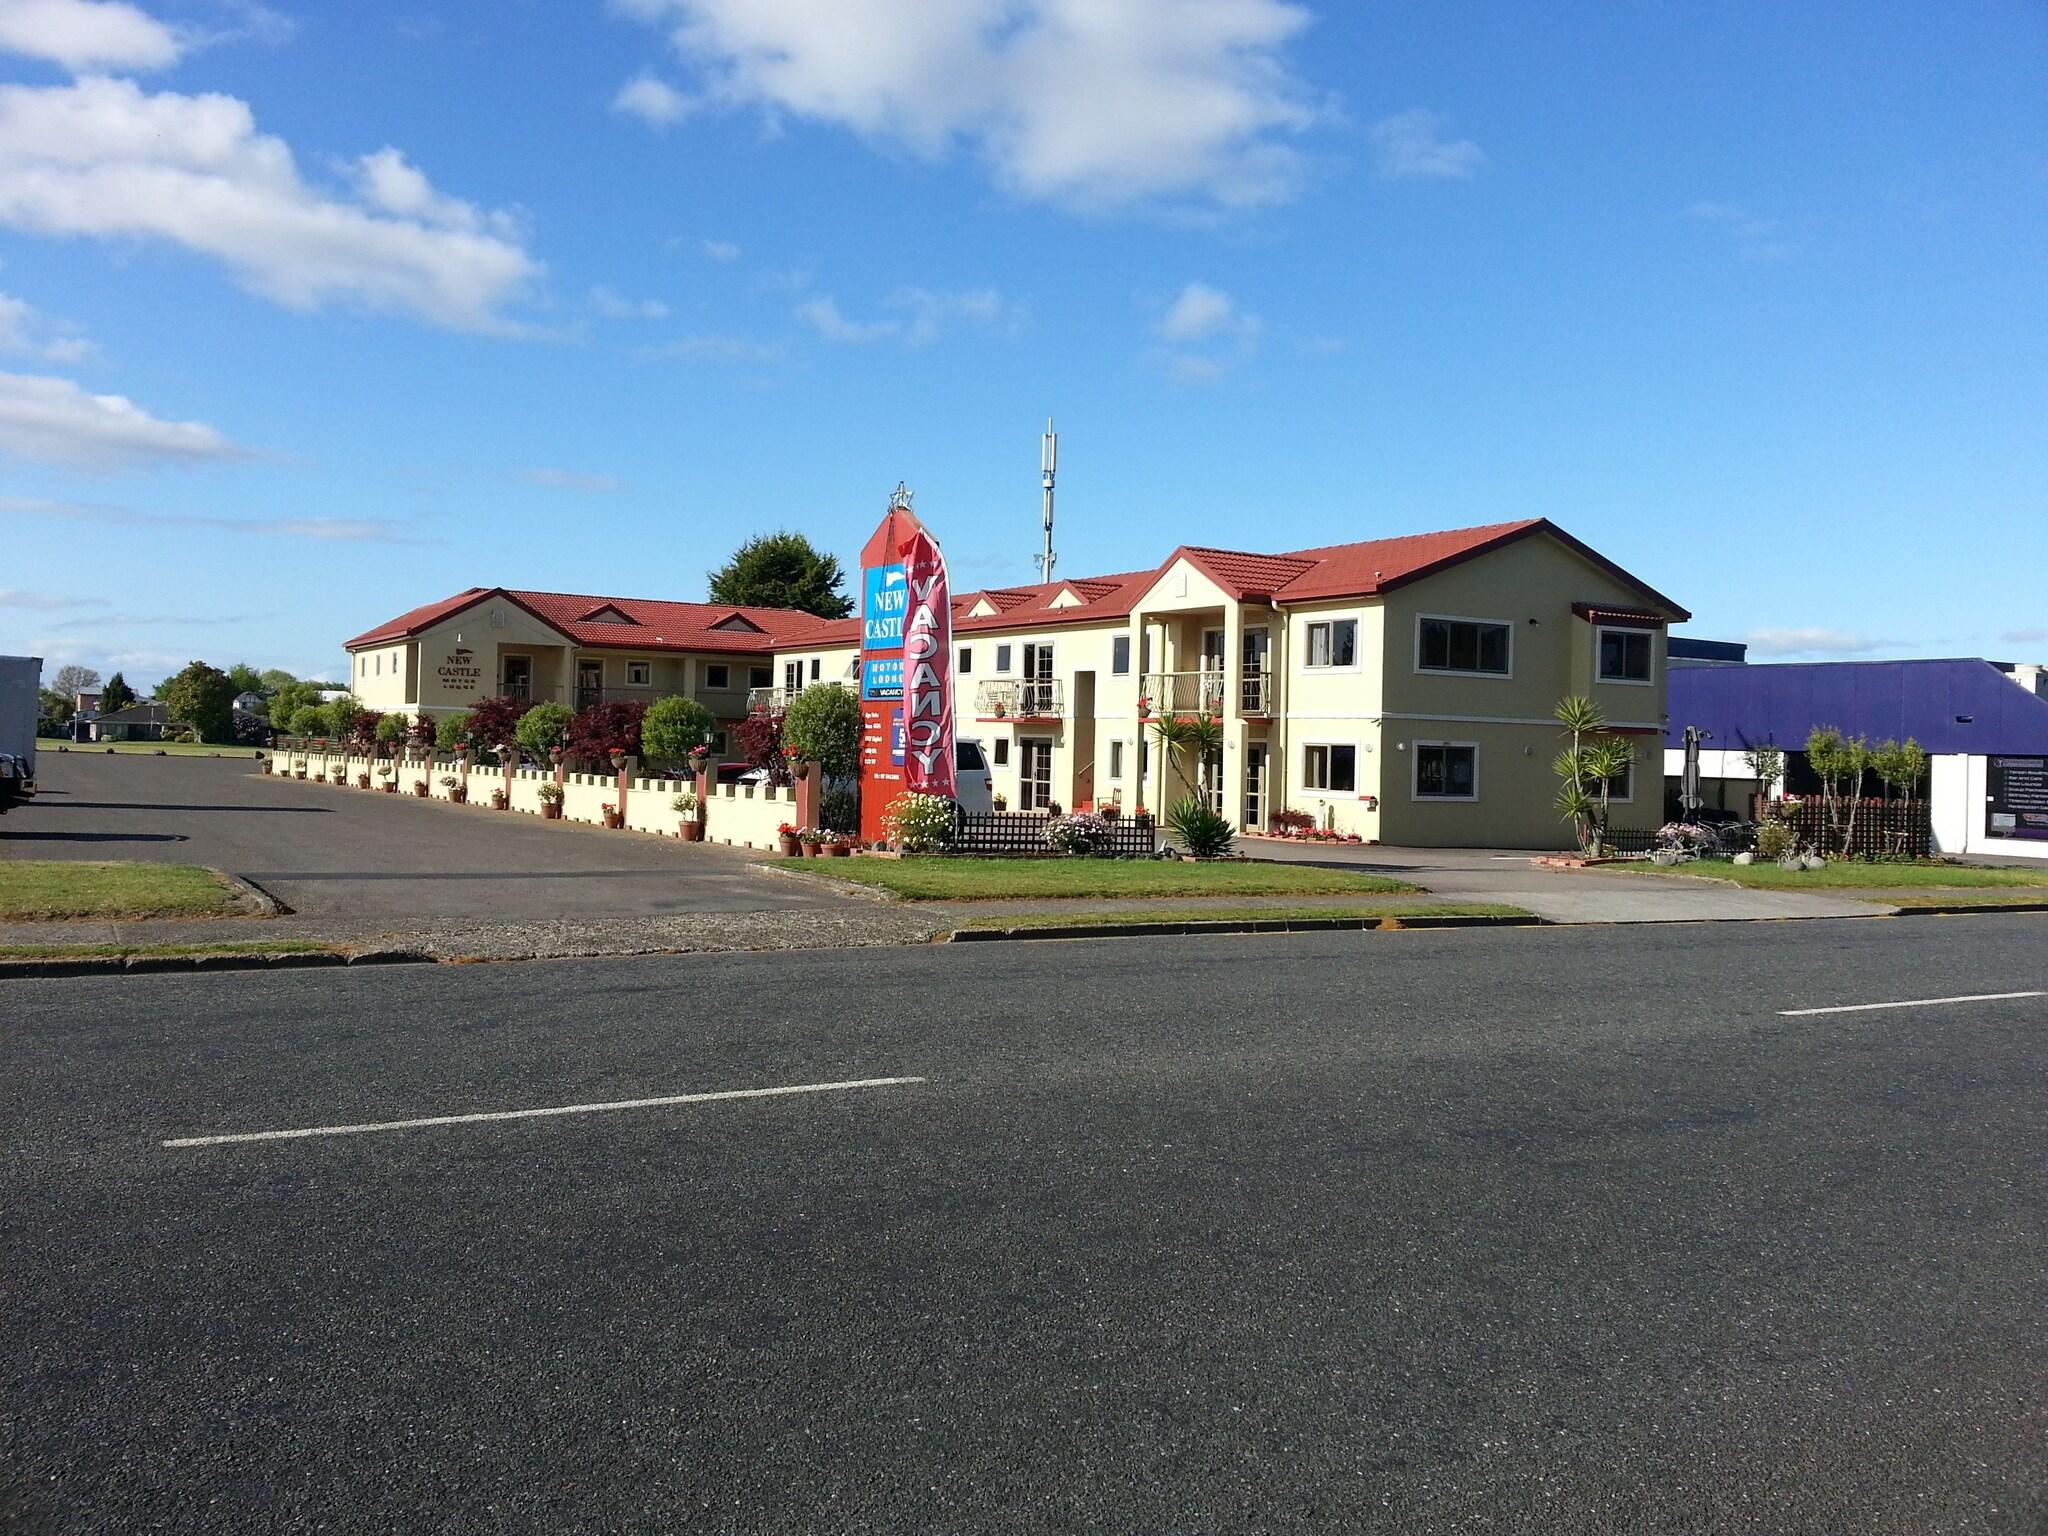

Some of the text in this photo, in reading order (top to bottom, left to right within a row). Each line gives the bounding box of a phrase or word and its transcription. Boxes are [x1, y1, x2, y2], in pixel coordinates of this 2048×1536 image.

[875, 589, 905, 611] NEW
[865, 617, 903, 640] CASTL
[447, 655, 472, 665] NEW
[438, 667, 481, 677] CASTLE
